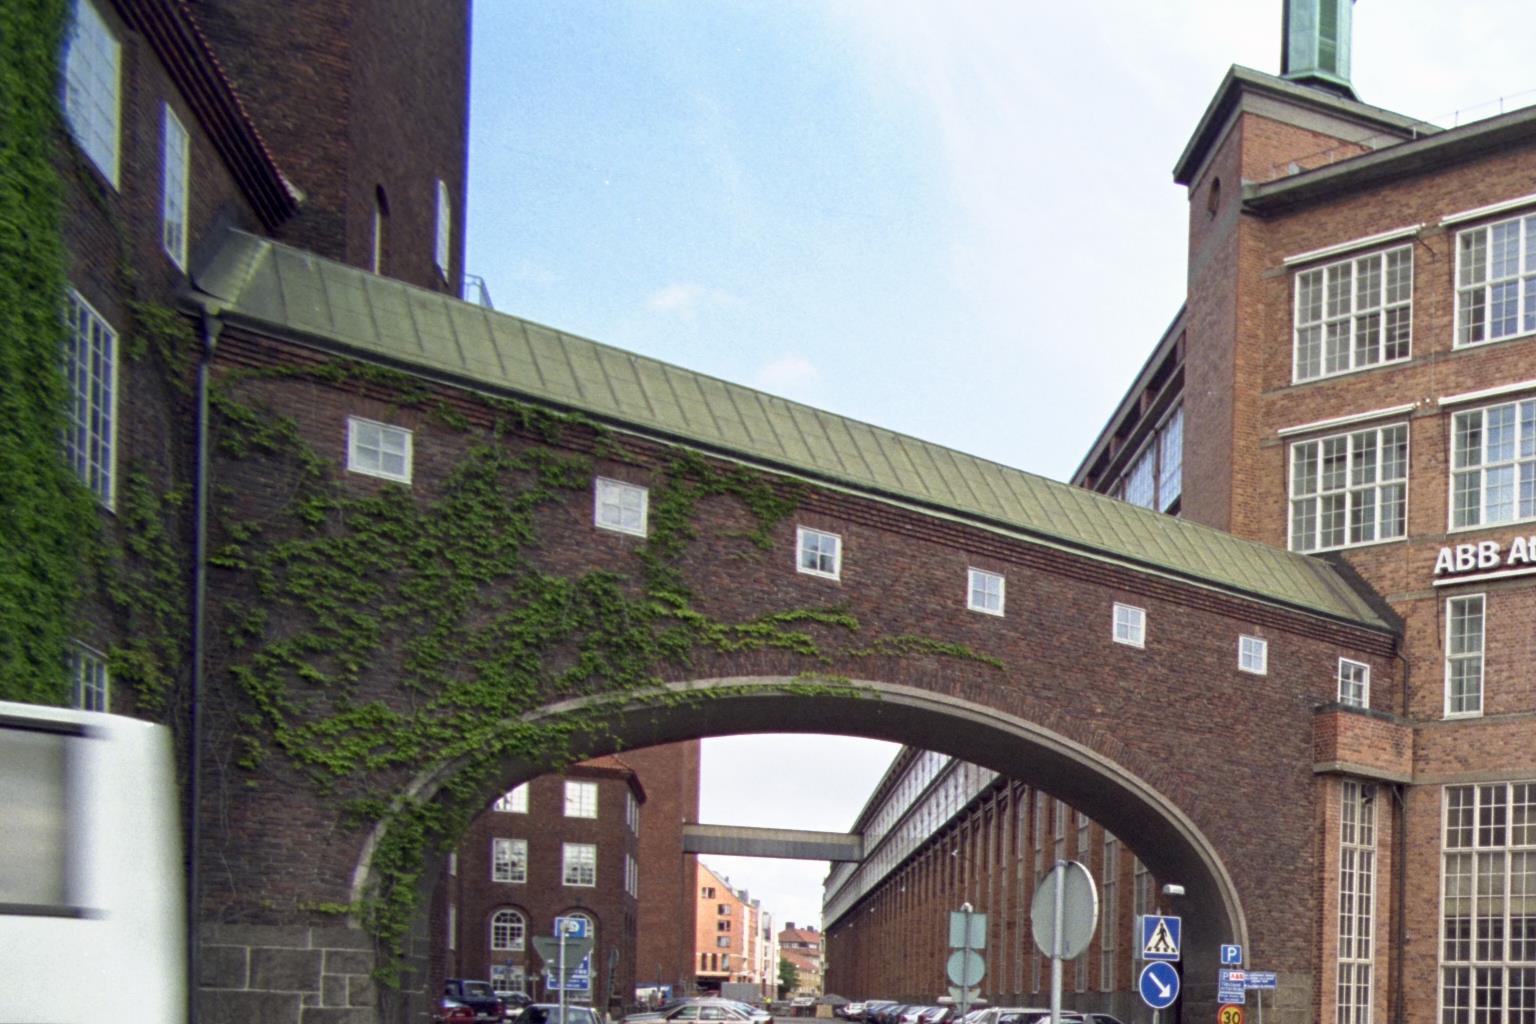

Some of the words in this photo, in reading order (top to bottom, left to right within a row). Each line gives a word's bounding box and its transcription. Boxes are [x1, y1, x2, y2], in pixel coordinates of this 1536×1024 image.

[1434, 541, 1500, 574] ABB
[1227, 947, 1237, 962] P
[1223, 1011, 1241, 1024] 30
